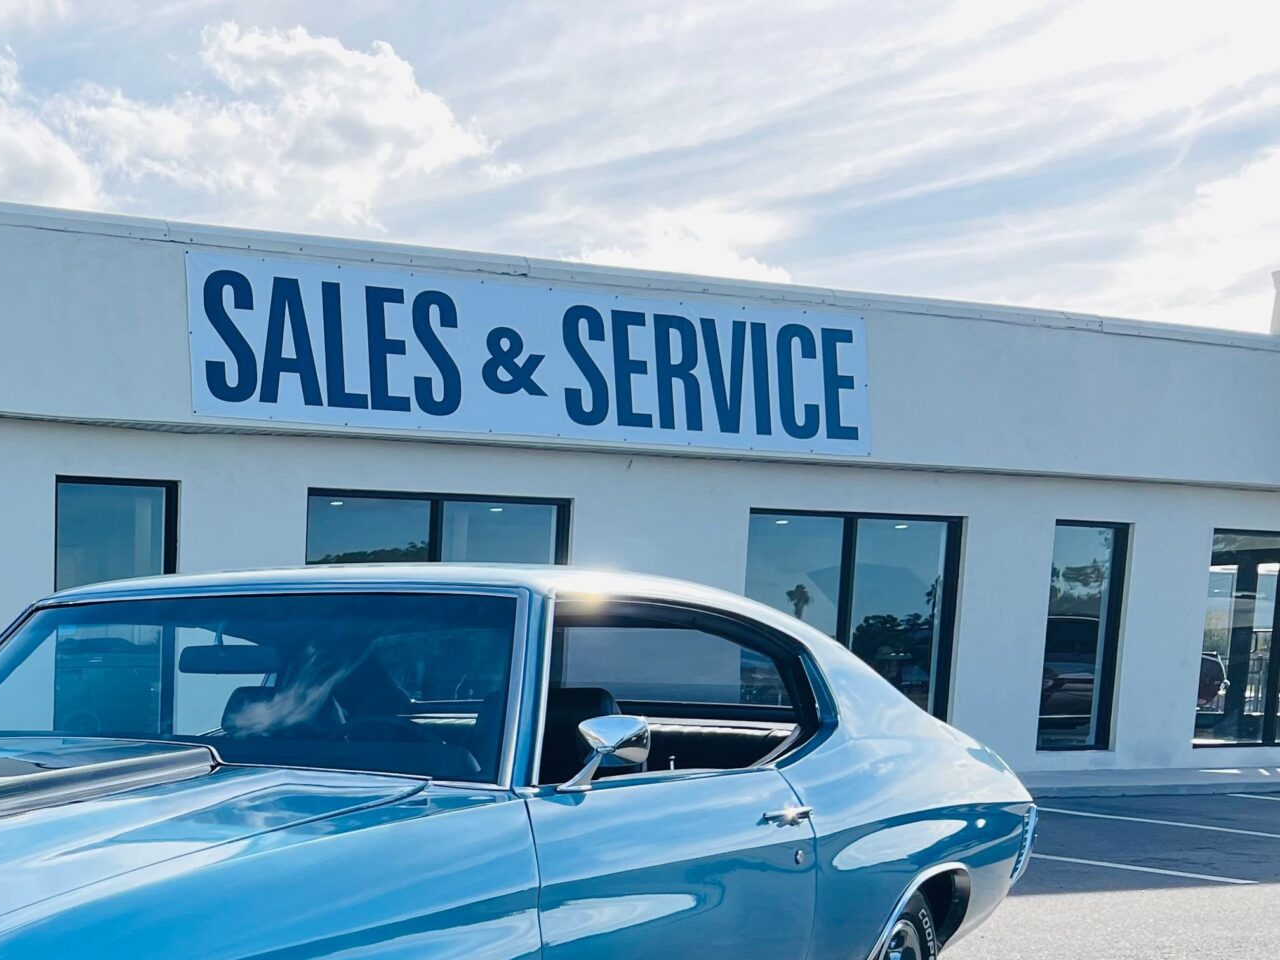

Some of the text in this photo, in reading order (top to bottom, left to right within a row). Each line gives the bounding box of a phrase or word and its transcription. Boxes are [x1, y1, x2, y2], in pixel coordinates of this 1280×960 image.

[203, 269, 859, 441] SALES & SERVICE
